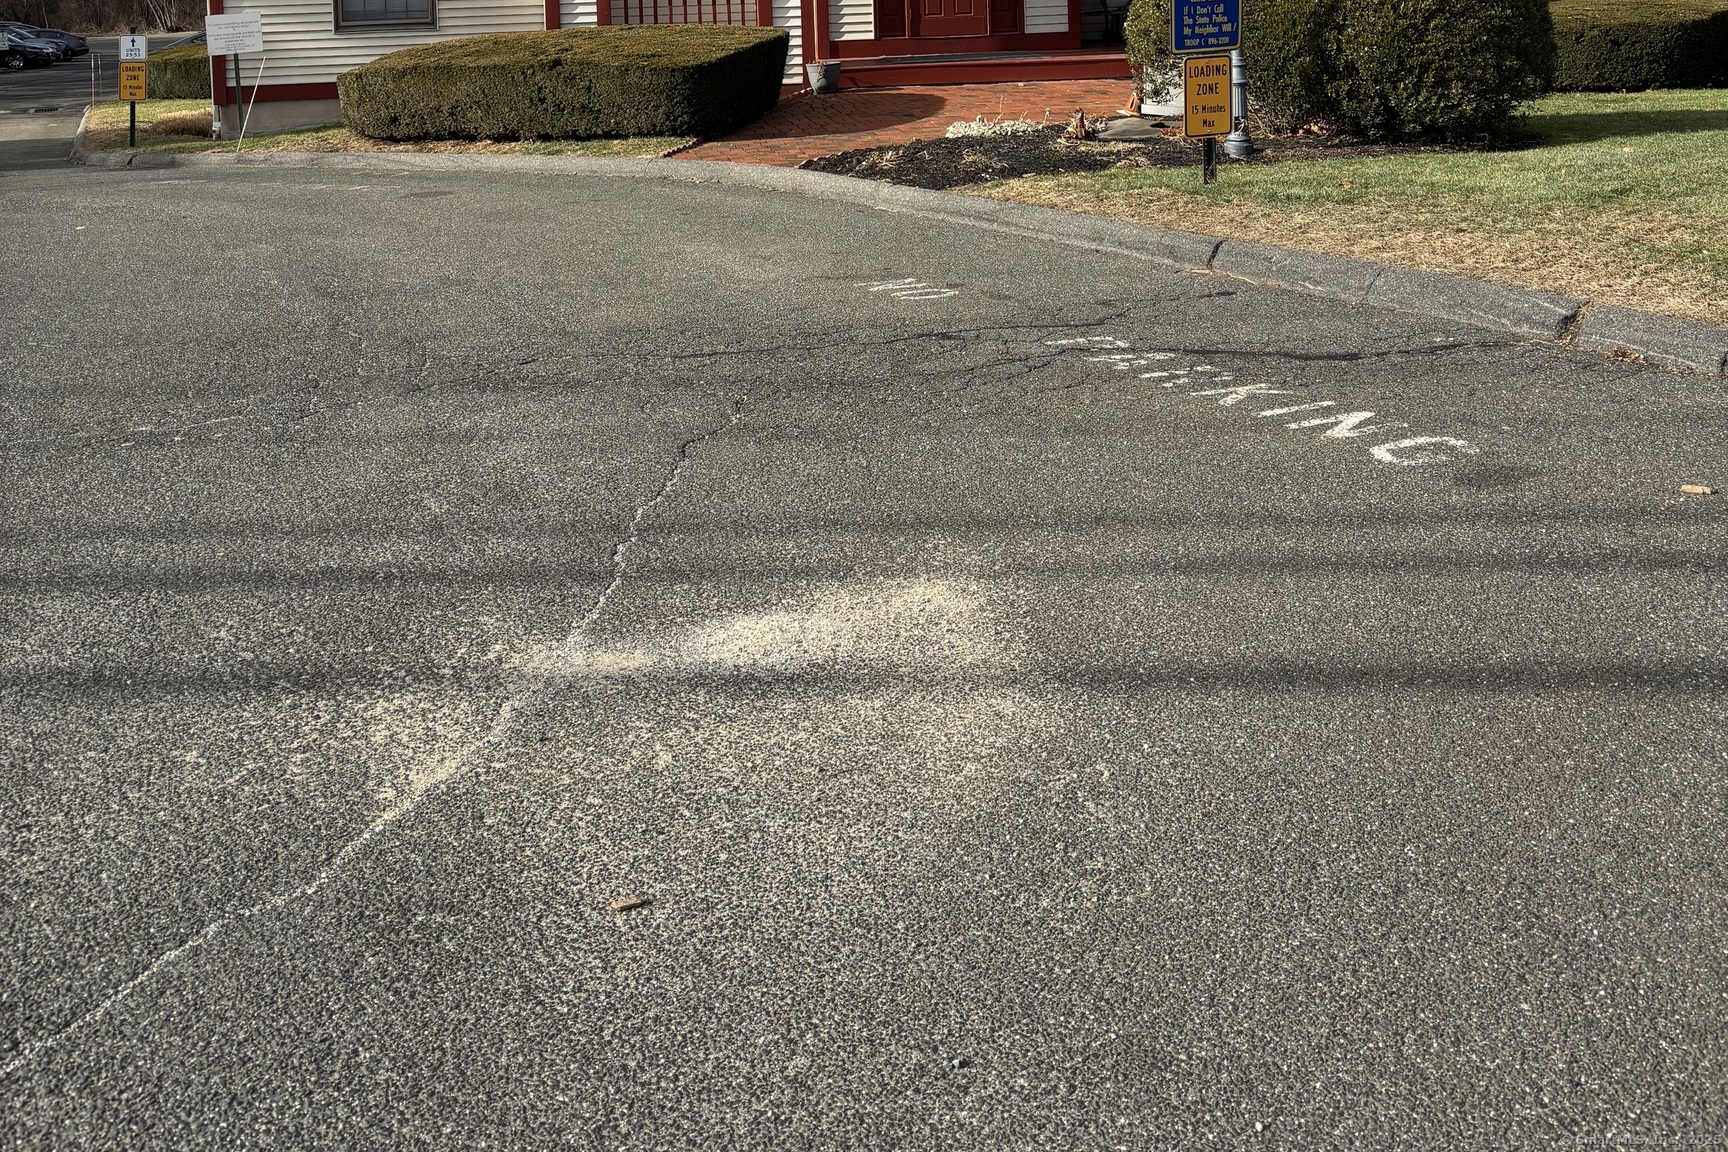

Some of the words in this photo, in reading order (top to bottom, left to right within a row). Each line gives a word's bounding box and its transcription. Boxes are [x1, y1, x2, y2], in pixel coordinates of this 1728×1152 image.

[1184, 6, 1189, 15] If
[1191, 6, 1194, 14] I
[1196, 5, 1211, 14] Don't
[1214, 4, 1224, 13] Call
[1183, 16, 1193, 24] The
[1196, 15, 1209, 24] State
[1212, 14, 1228, 23] Police
[1183, 26, 1192, 36] My
[1194, 24, 1219, 36] Neighbor
[1189, 64, 1227, 78] LOADING
[1196, 82, 1219, 96] ZONE
[1192, 105, 1199, 115] 15
[1201, 104, 1226, 114] Minutes
[1202, 119, 1215, 128] Max
